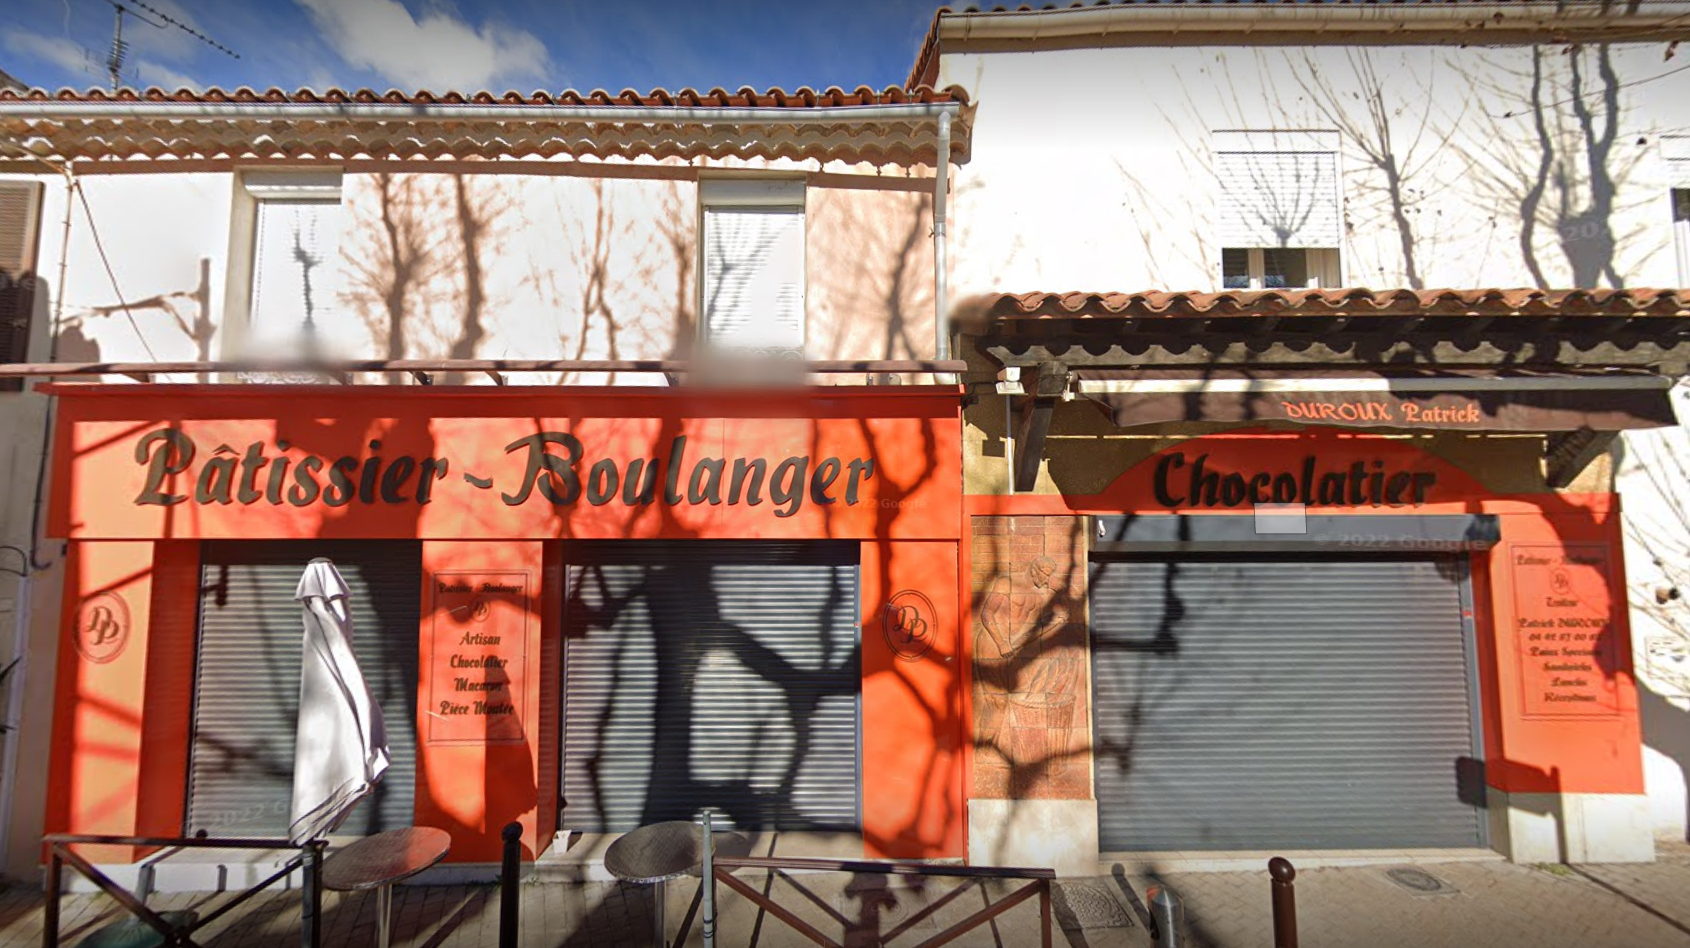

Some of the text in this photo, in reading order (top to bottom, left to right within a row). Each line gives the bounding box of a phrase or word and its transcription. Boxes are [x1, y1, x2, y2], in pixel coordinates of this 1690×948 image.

[1280, 401, 1480, 422] DUROUX Patrick
[133, 427, 449, 507] Pâtissier
[500, 431, 875, 518] Boulanger
[1153, 452, 1437, 508] Chocolatier
[459, 631, 501, 646] Artisan
[450, 653, 509, 670] Chocolatier
[453, 677, 503, 693] Macaron
